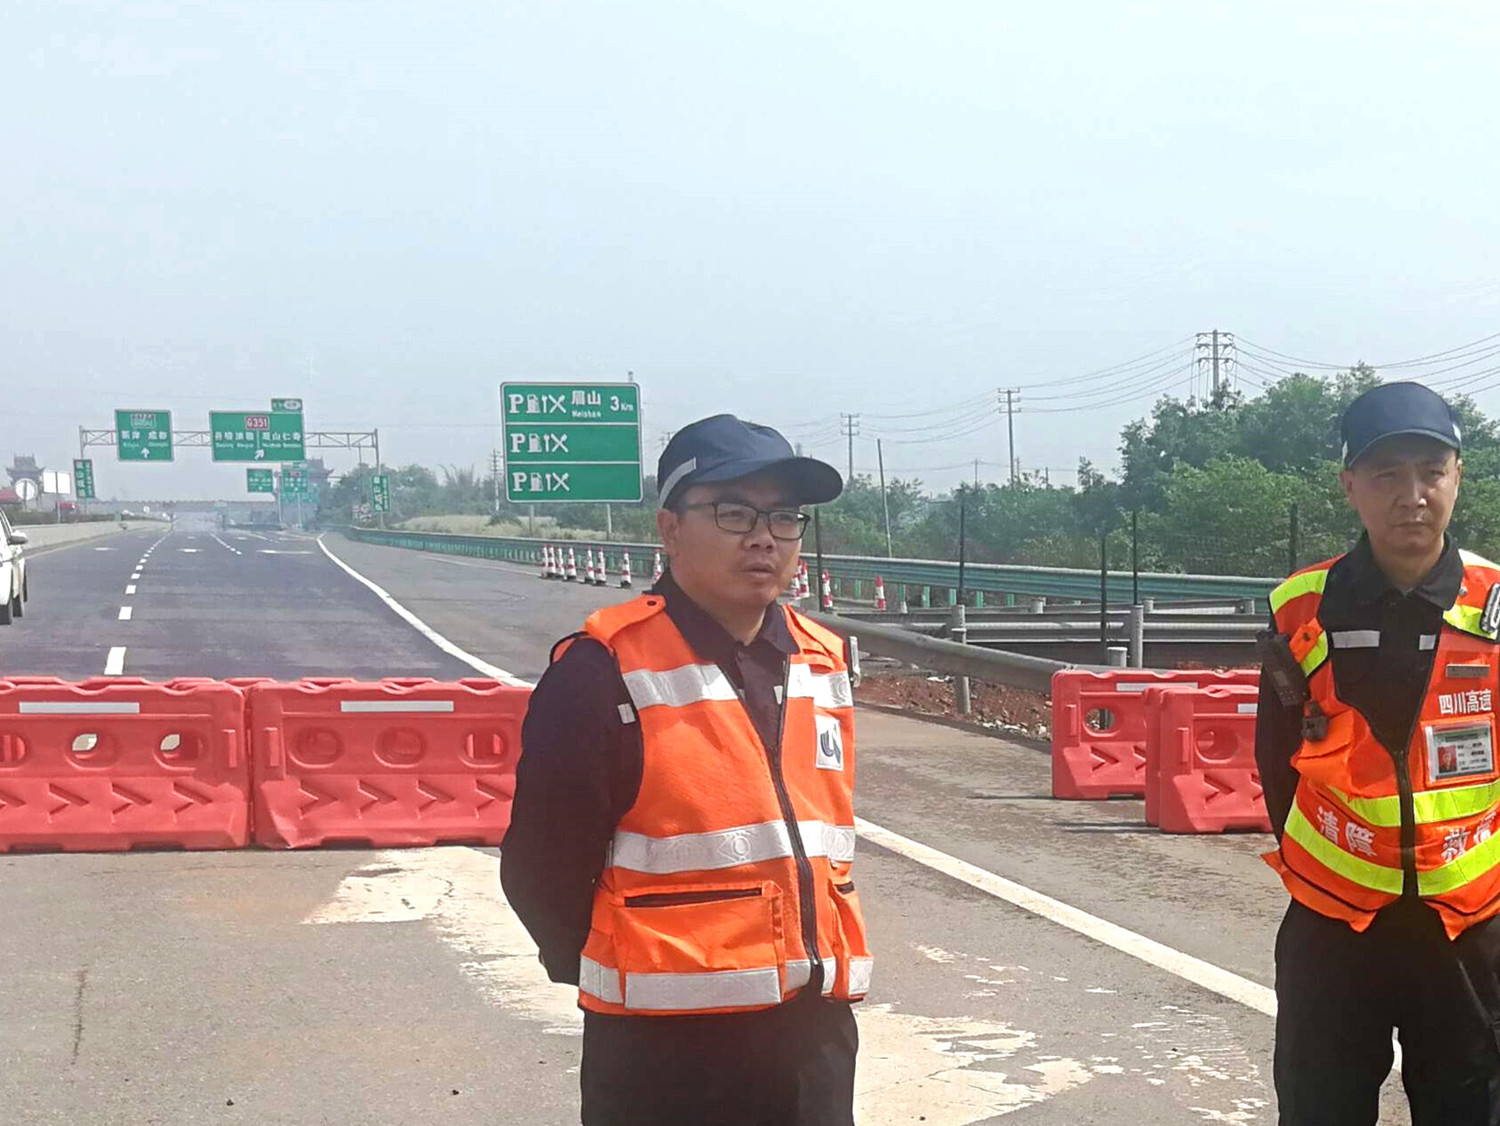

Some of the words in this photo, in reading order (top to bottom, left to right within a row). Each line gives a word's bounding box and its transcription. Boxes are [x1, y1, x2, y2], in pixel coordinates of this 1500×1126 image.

[247, 418, 267, 428] G351
[1438, 688, 1492, 715] 四川高速
